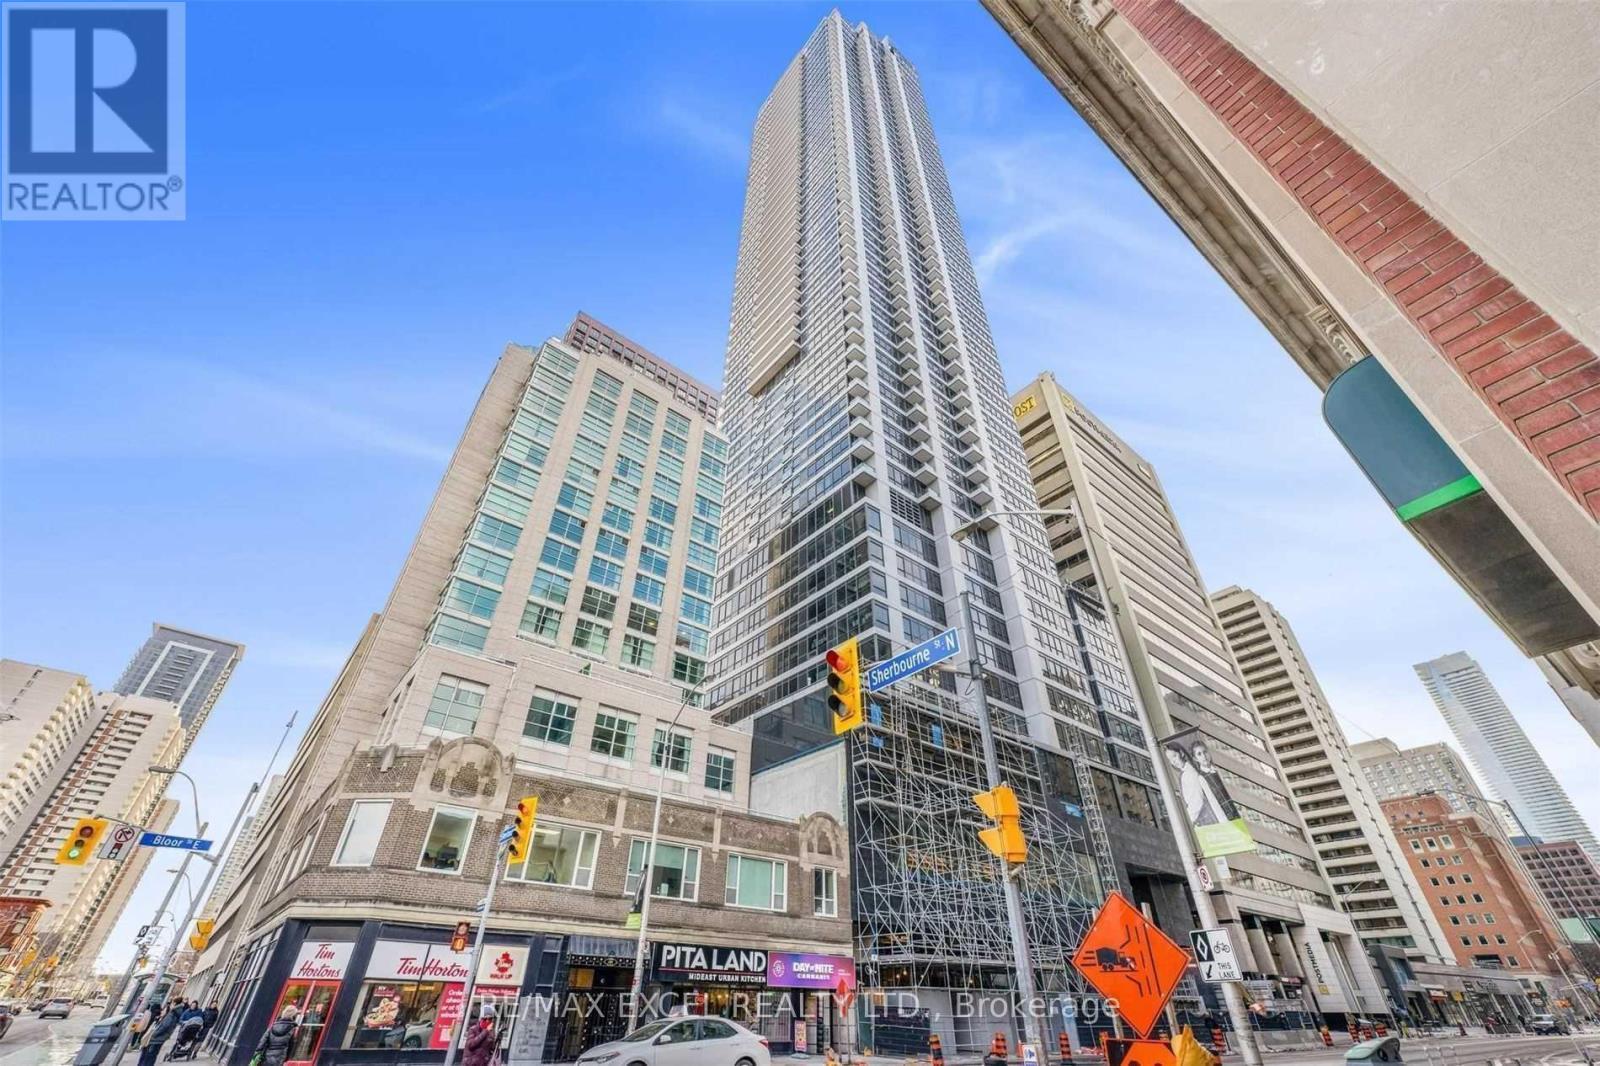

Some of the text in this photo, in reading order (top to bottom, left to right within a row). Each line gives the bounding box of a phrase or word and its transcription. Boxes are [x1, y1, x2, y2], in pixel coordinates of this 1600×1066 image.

[871, 648, 930, 686] Sherbourne
[945, 632, 955, 651] N
[153, 836, 184, 847] Bloor
[192, 841, 200, 850] E
[314, 943, 335, 960] Tim
[660, 944, 767, 972] PITA LAND
[296, 960, 342, 978] Hortons
[397, 957, 469, 977] Tim Horton
[1217, 961, 1232, 970] THIS
[1218, 970, 1236, 979] LANE
